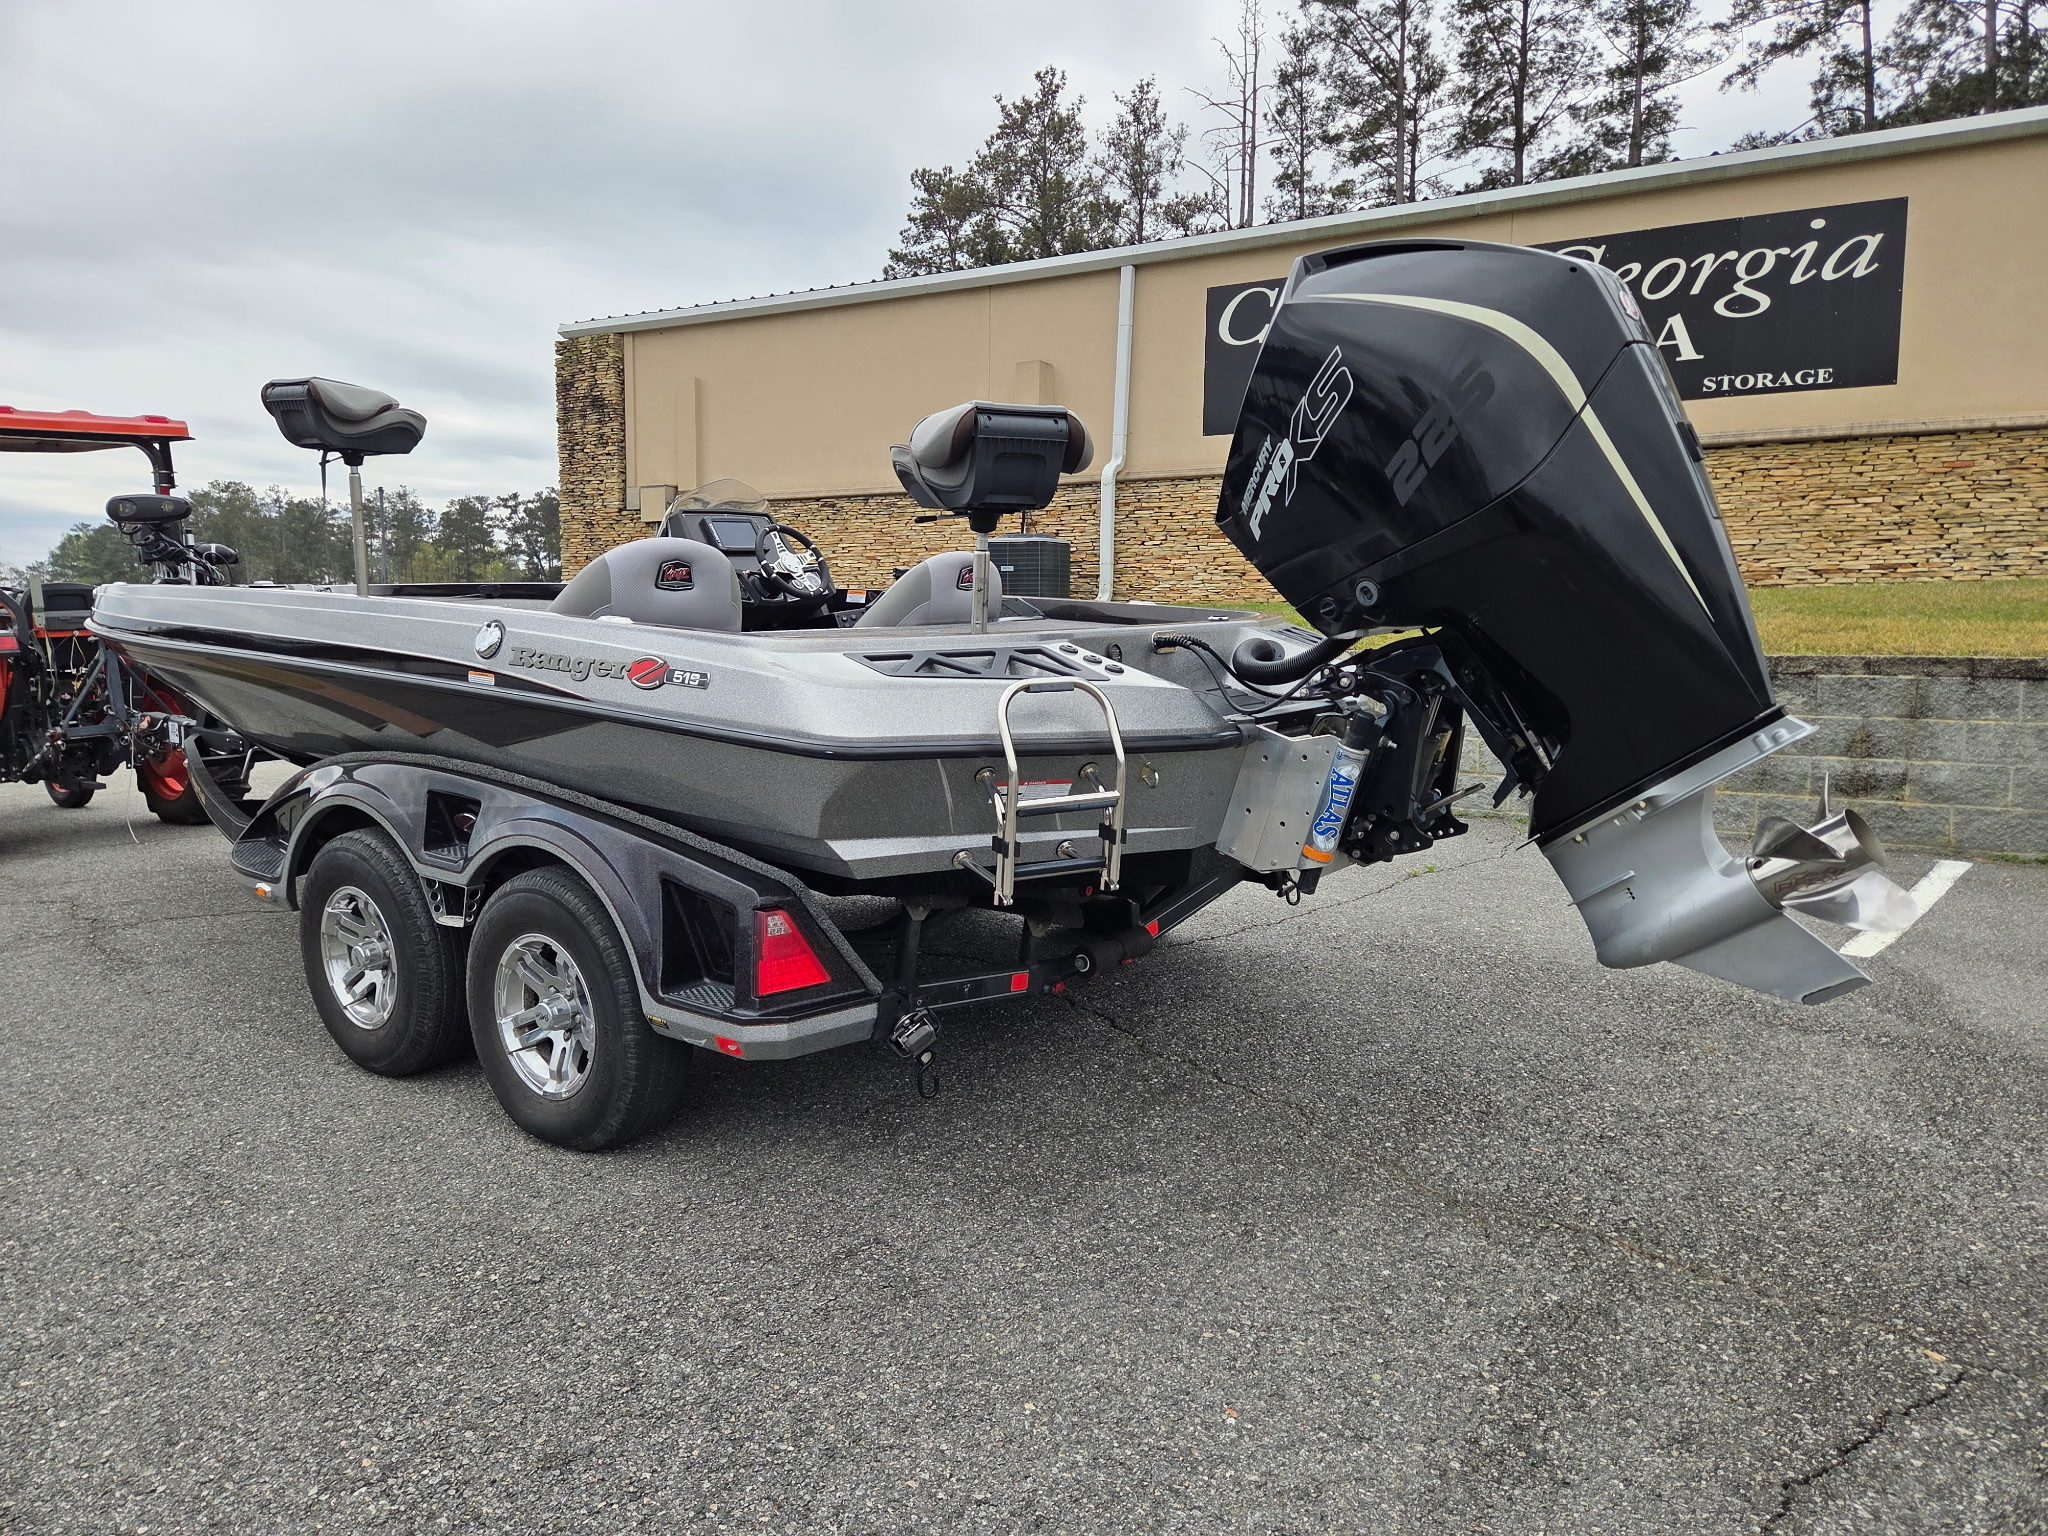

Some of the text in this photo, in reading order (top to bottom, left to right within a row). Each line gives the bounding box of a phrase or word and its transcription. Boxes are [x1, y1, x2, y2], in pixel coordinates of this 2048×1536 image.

[1554, 218, 1884, 318] eorgia
[1702, 367, 1835, 393] STORAGE
[1384, 355, 1497, 508] 225
[1240, 433, 1273, 517] MERCURY
[507, 646, 632, 682] Ranger
[672, 670, 701, 686] 519
[1312, 766, 1356, 840] ATLAS
